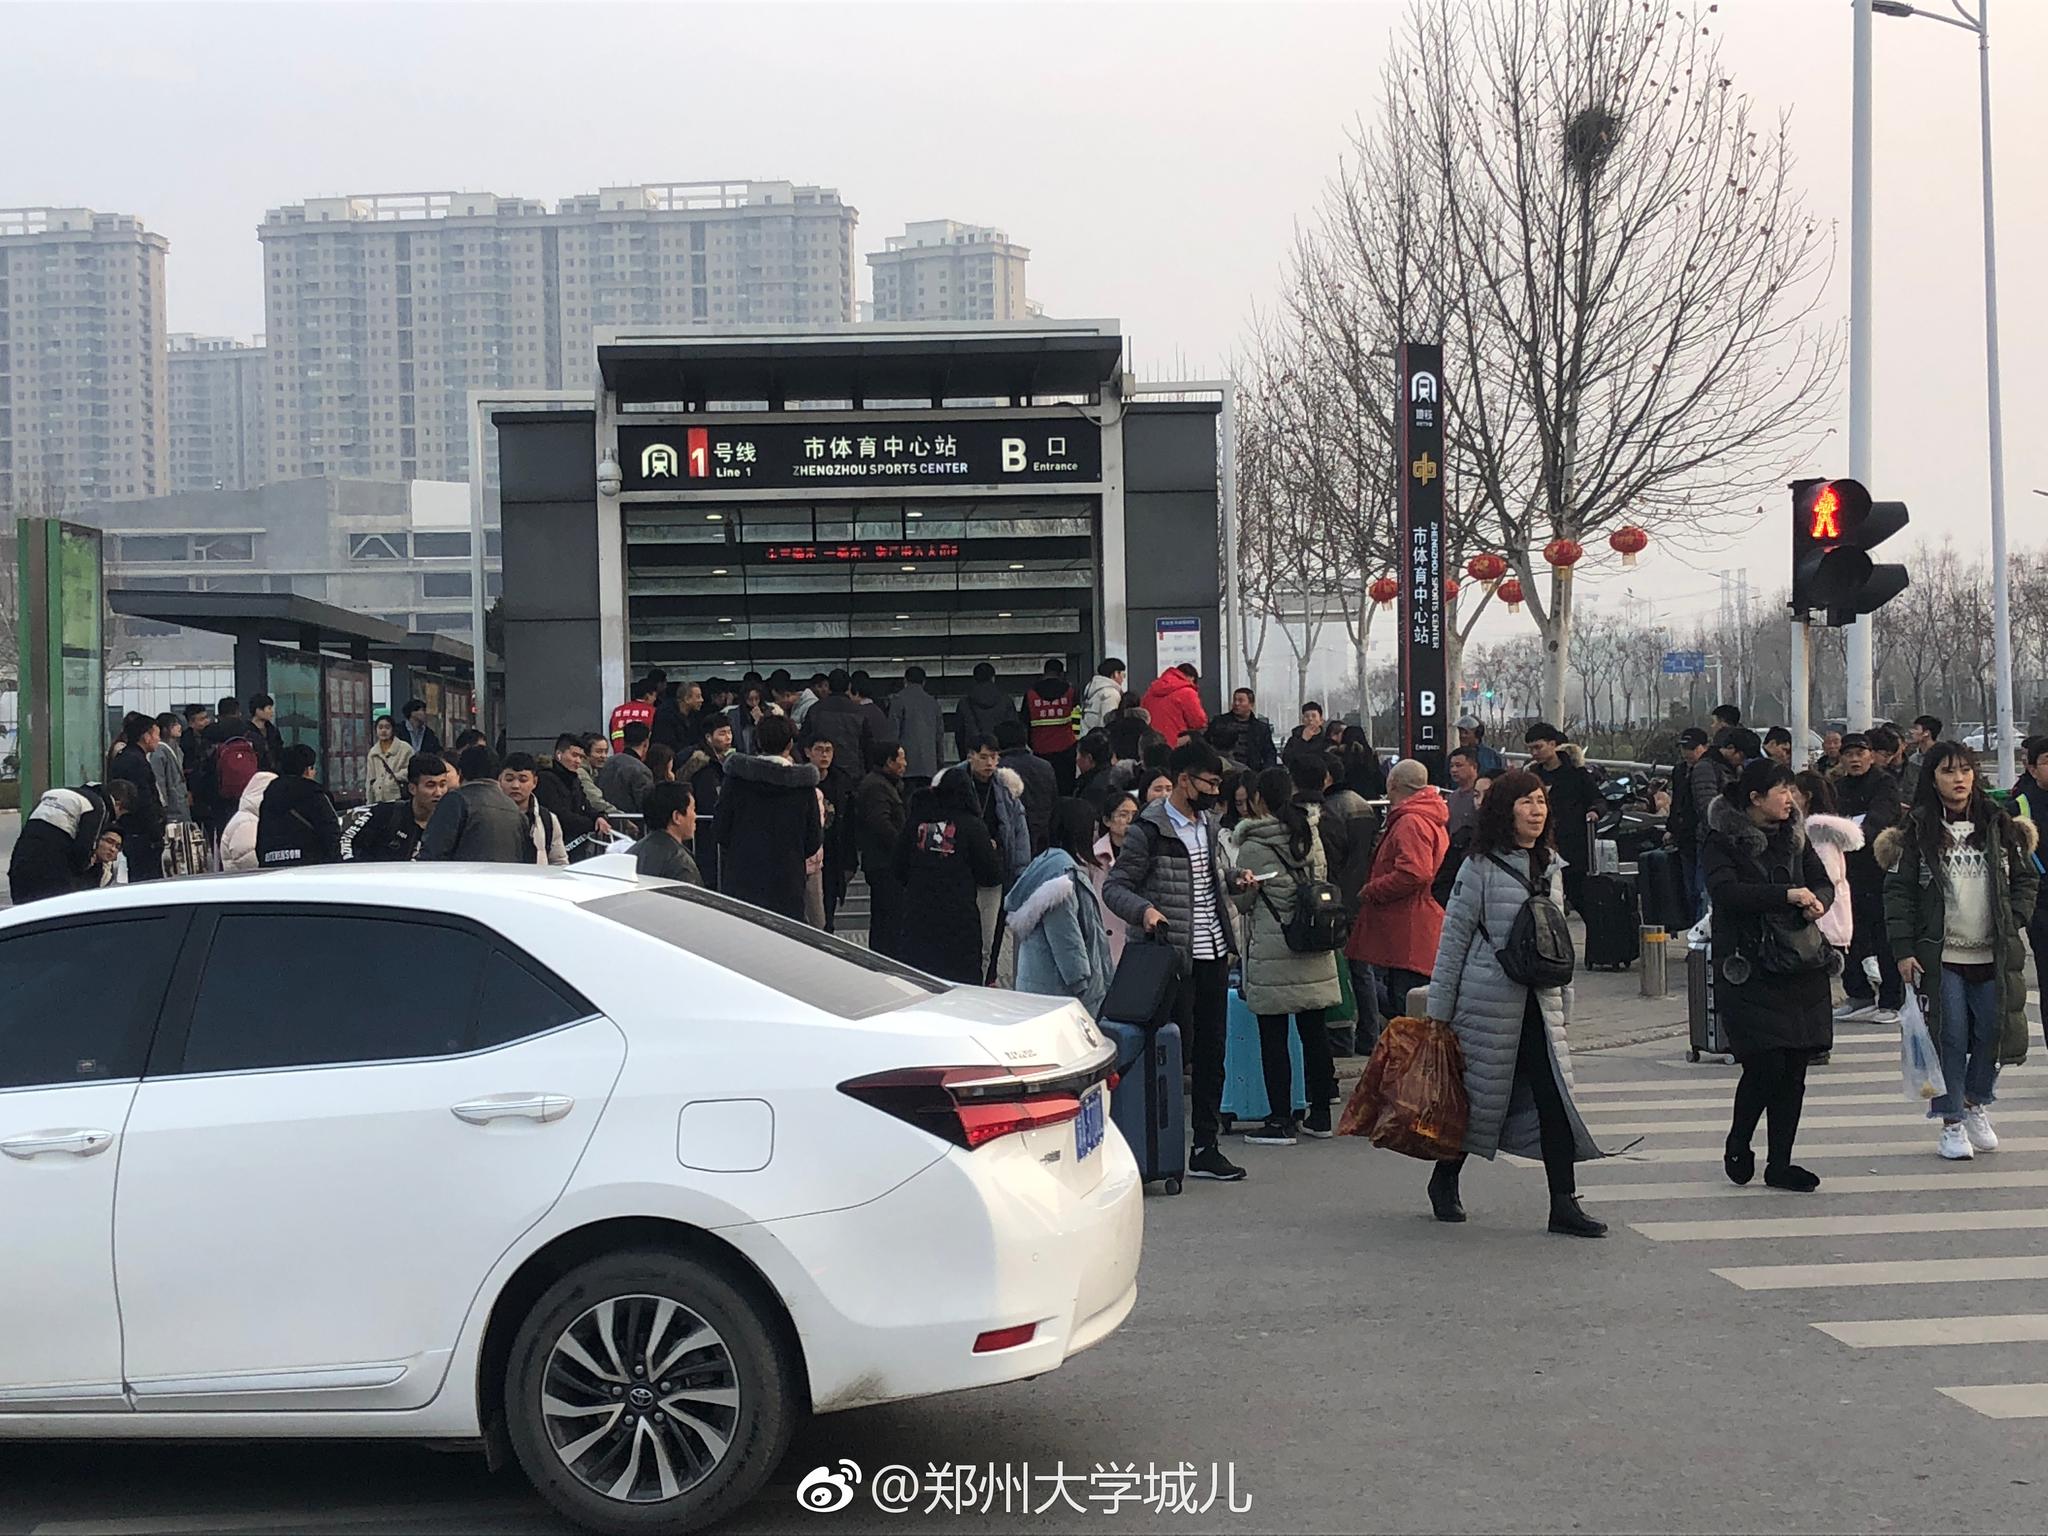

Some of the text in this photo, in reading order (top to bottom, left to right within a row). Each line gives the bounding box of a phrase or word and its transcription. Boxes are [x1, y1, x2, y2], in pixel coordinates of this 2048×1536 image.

[803, 435, 957, 460] 市体育中心站
[1002, 437, 1027, 472] B
[1047, 437, 1066, 456] 口
[691, 442, 757, 477] 1 号线
[716, 467, 752, 477] Line 1
[793, 462, 968, 476] ZHENGZHOU SPORTS CENTER
[1033, 461, 1078, 472] Entrance
[1413, 526, 1429, 644] 市体育中心站
[1431, 521, 1440, 649] ZHENGZHOU SPORTS CENTER
[1420, 690, 1436, 716] B
[1422, 725, 1433, 740] 口
